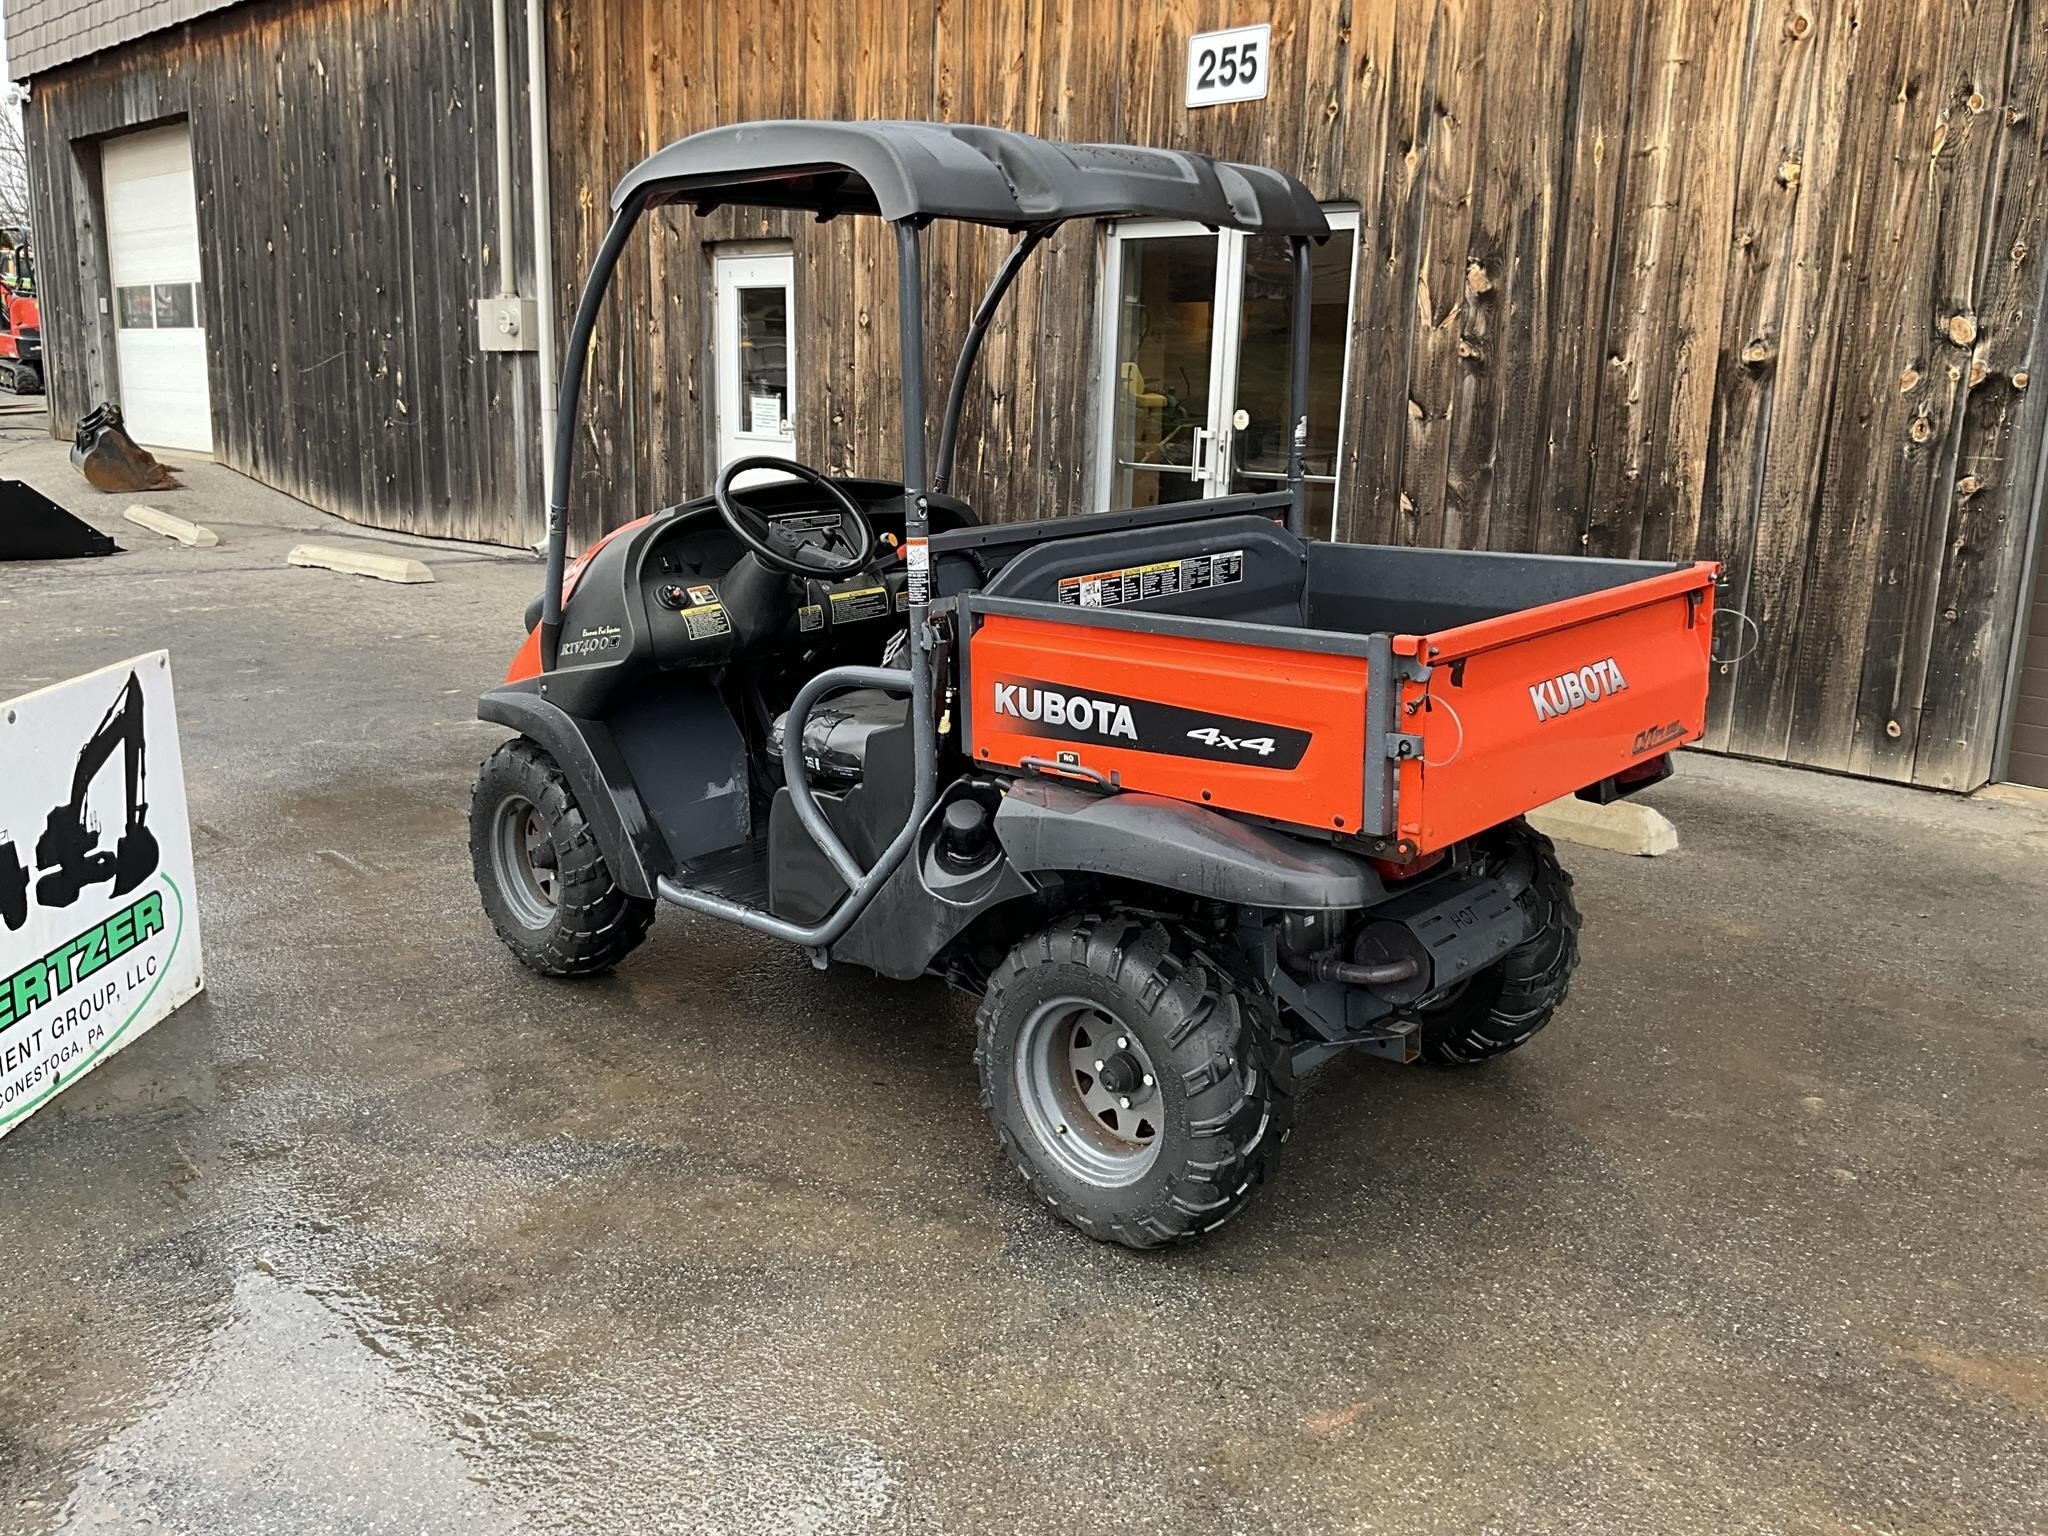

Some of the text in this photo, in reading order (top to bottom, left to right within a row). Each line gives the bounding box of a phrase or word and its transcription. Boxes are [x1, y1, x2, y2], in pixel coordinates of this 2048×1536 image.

[1196, 42, 1258, 91] 255
[1528, 656, 1629, 722] KUBOTA
[993, 681, 1138, 741] KUBOTA
[1063, 754, 1075, 762] NO
[1186, 727, 1276, 756] 4x4
[1450, 906, 1479, 930] HOT
[0, 955, 157, 1078] ENT GROUP, LLC
[88, 1024, 104, 1045] PA
